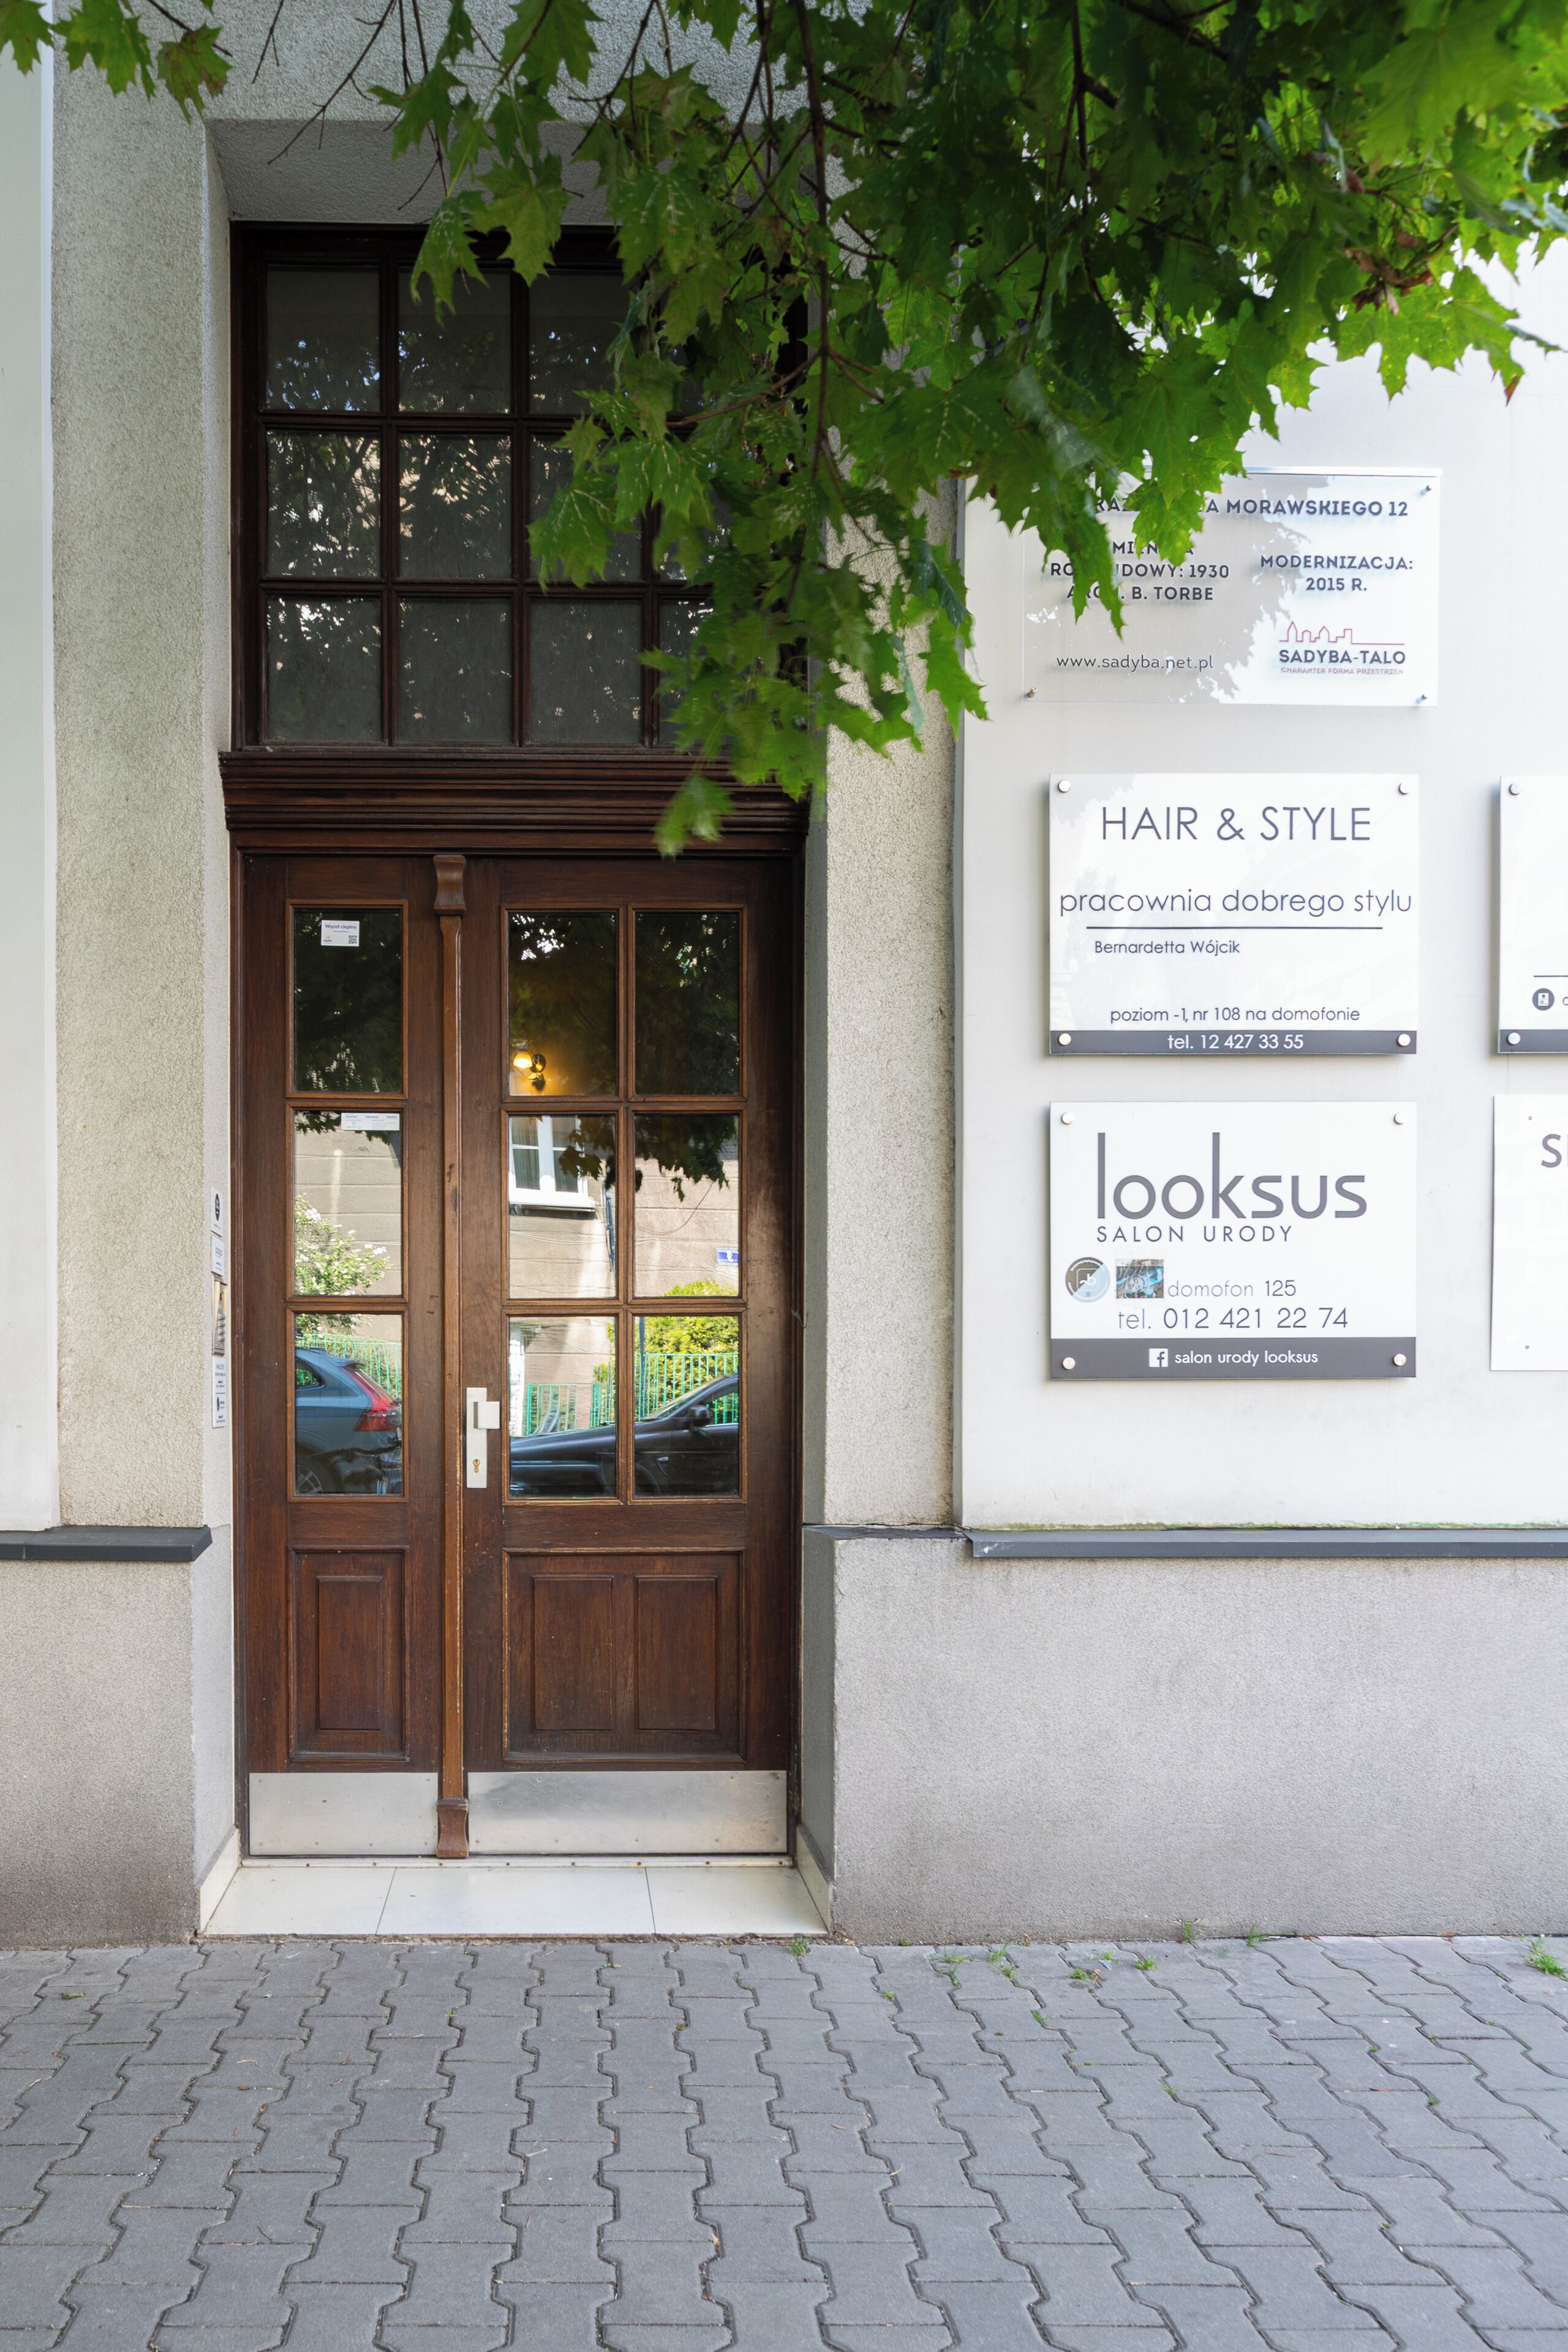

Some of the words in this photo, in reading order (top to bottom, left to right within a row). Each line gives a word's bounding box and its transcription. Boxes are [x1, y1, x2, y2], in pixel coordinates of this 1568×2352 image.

[1227, 499, 1382, 516] MORAWSKIEGO
[1389, 502, 1408, 516] 12
[1189, 564, 1229, 578] 1930
[1261, 555, 1413, 570] MODERNIZACJA:
[1132, 586, 1147, 600] B.
[1153, 586, 1213, 600] TORBE
[1306, 578, 1345, 592] 2015
[1352, 578, 1368, 592] R.
[1057, 655, 1214, 673] www.sadyba.net.pl
[1279, 649, 1406, 665] SADYBA-TALO
[1102, 807, 1198, 840] HAIR
[1216, 808, 1245, 841] &
[1260, 806, 1370, 841] STYLE
[1061, 889, 1211, 917] pracownia
[1223, 889, 1344, 918] dobrego
[1354, 889, 1411, 917] stylu
[1095, 941, 1185, 954] Bernardetta
[1191, 940, 1240, 957] Wójcik
[1111, 1008, 1169, 1024] poziom
[1193, 1010, 1209, 1021] nr
[1215, 1007, 1241, 1021] 108
[1246, 1010, 1267, 1021] na
[1272, 1007, 1360, 1021] domofonie
[1167, 1035, 1194, 1049] tel.
[1200, 1035, 1219, 1049] 12
[1224, 1035, 1254, 1049] 427
[1259, 1035, 1279, 1049] 33
[1284, 1035, 1304, 1049] 55
[1098, 1133, 1367, 1220] looksus
[1096, 1225, 1183, 1243] SALON
[1204, 1225, 1292, 1243] URODY
[1168, 1280, 1254, 1297] domofon
[1265, 1280, 1297, 1297] 125
[1118, 1310, 1152, 1330] tel.
[1163, 1308, 1210, 1329] 012
[1219, 1308, 1262, 1329] 421
[1276, 1308, 1308, 1329] 22
[1318, 1307, 1349, 1329] 74
[1174, 1350, 1212, 1364] salon
[1218, 1350, 1260, 1367] urody
[1265, 1350, 1319, 1364] looksus
